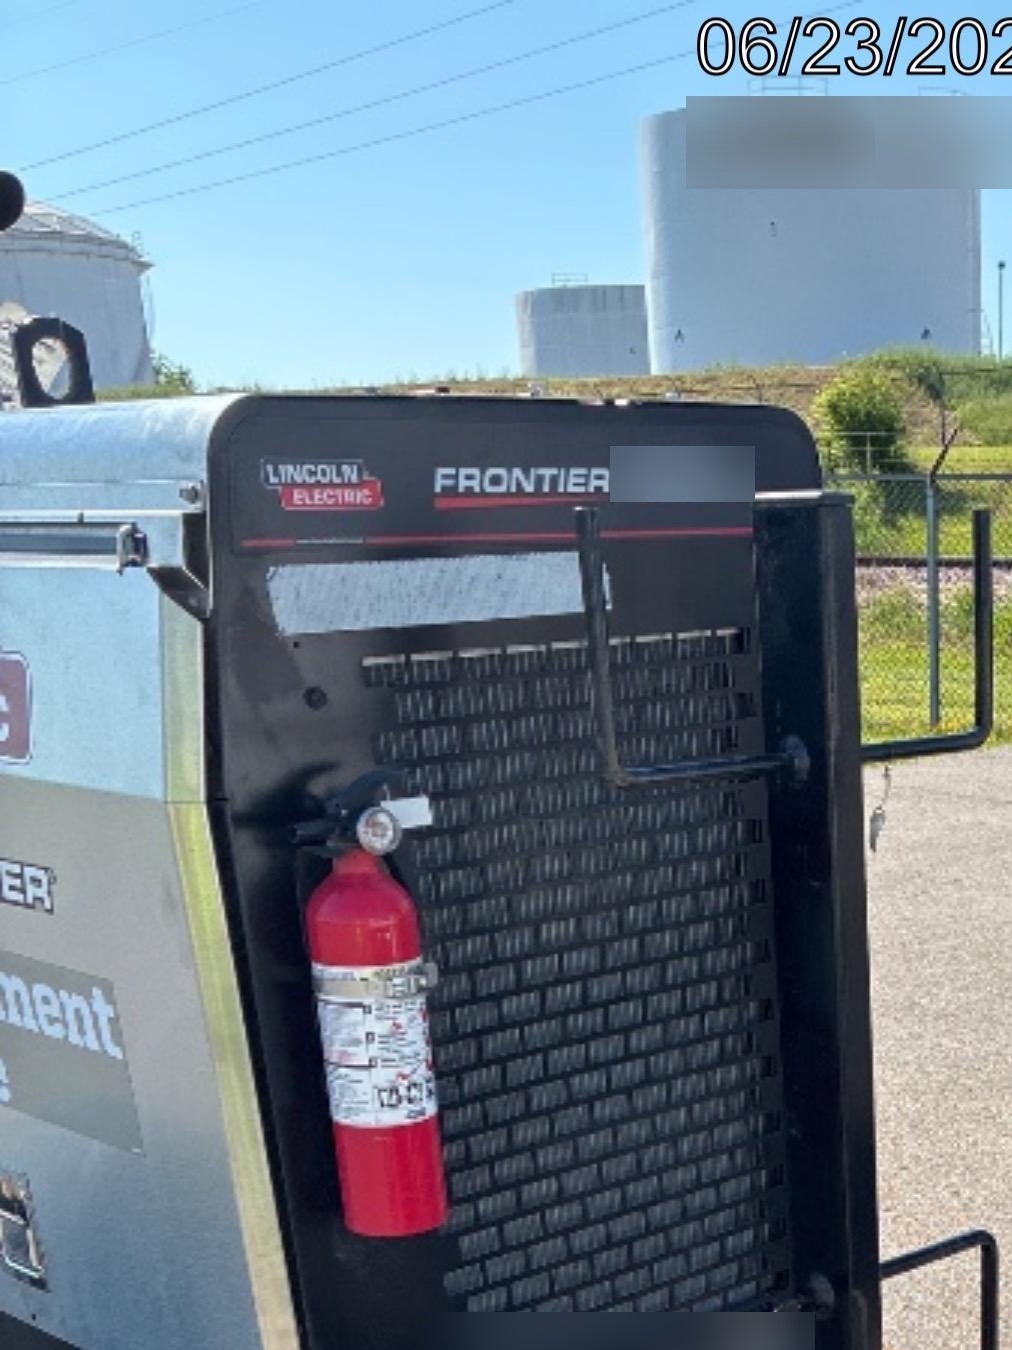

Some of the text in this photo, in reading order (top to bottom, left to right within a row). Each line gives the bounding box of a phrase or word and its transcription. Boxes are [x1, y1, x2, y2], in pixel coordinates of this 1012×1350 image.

[265, 463, 360, 485] LINCOLN
[433, 466, 610, 494] FRONTIER
[292, 487, 373, 506] ELECTRIC
